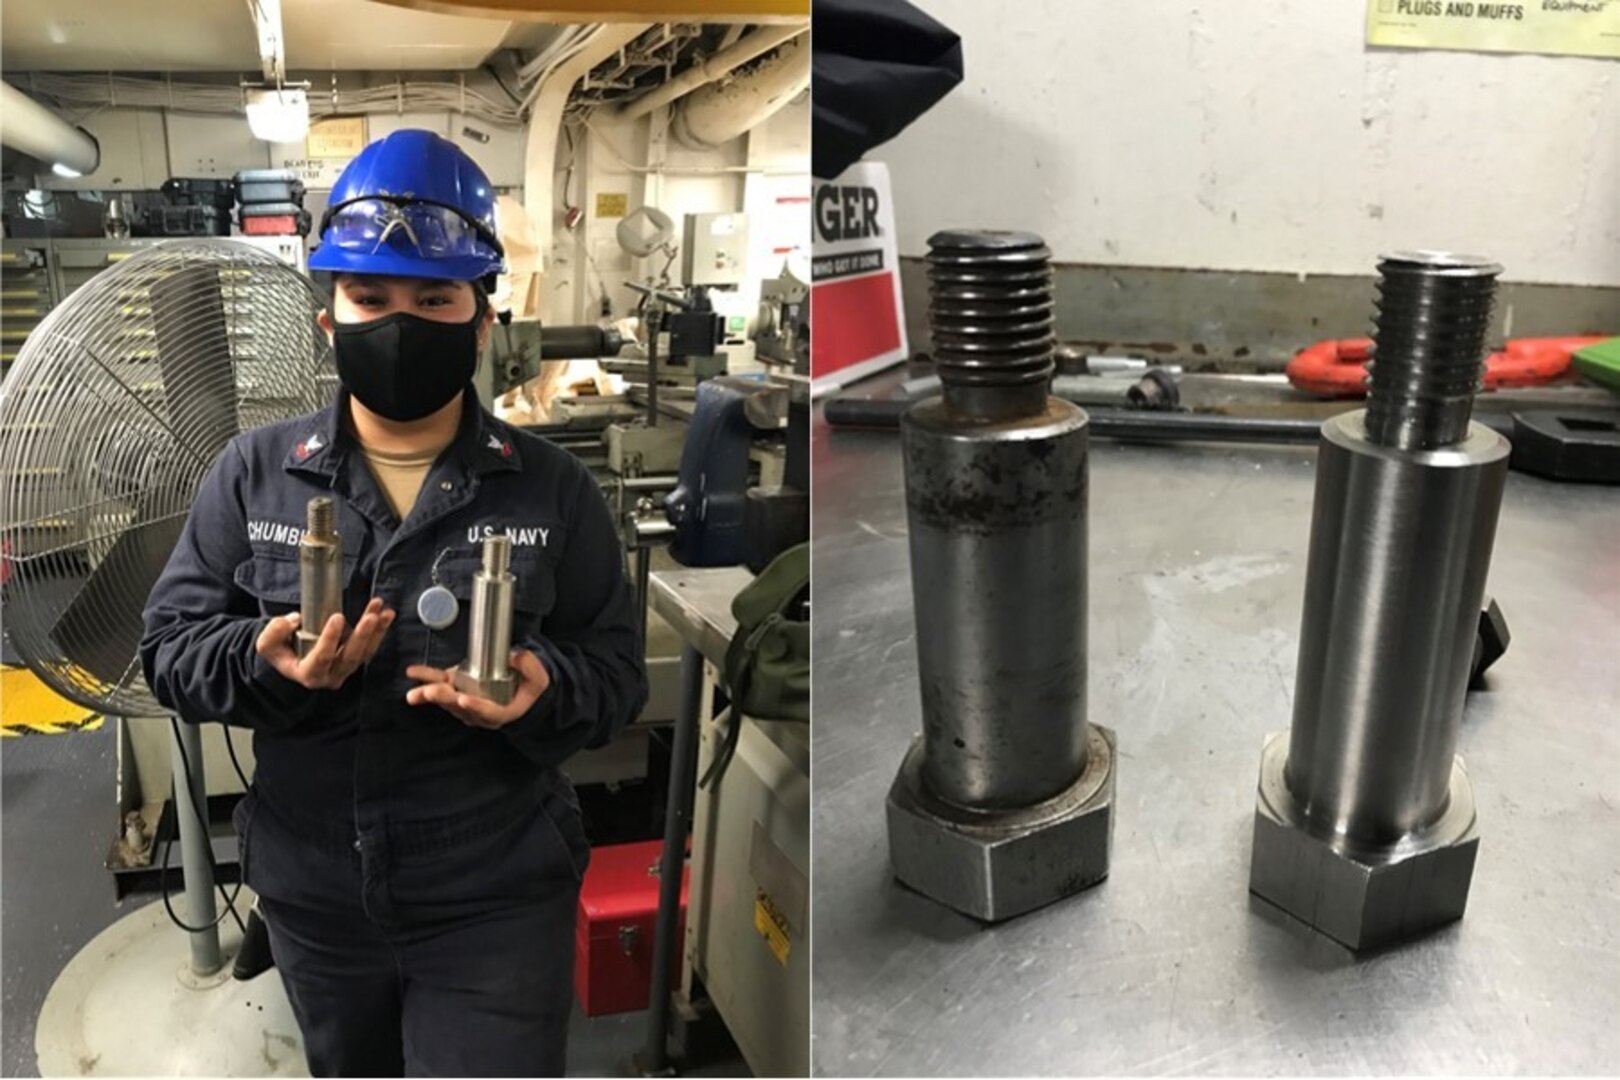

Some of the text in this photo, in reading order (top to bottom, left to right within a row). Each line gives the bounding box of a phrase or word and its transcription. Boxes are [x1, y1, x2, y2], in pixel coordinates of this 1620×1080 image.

[1397, 0, 1524, 21] PLUGS AND MUFFS
[812, 184, 880, 243] GER
[468, 525, 549, 546] U.S NAVY
